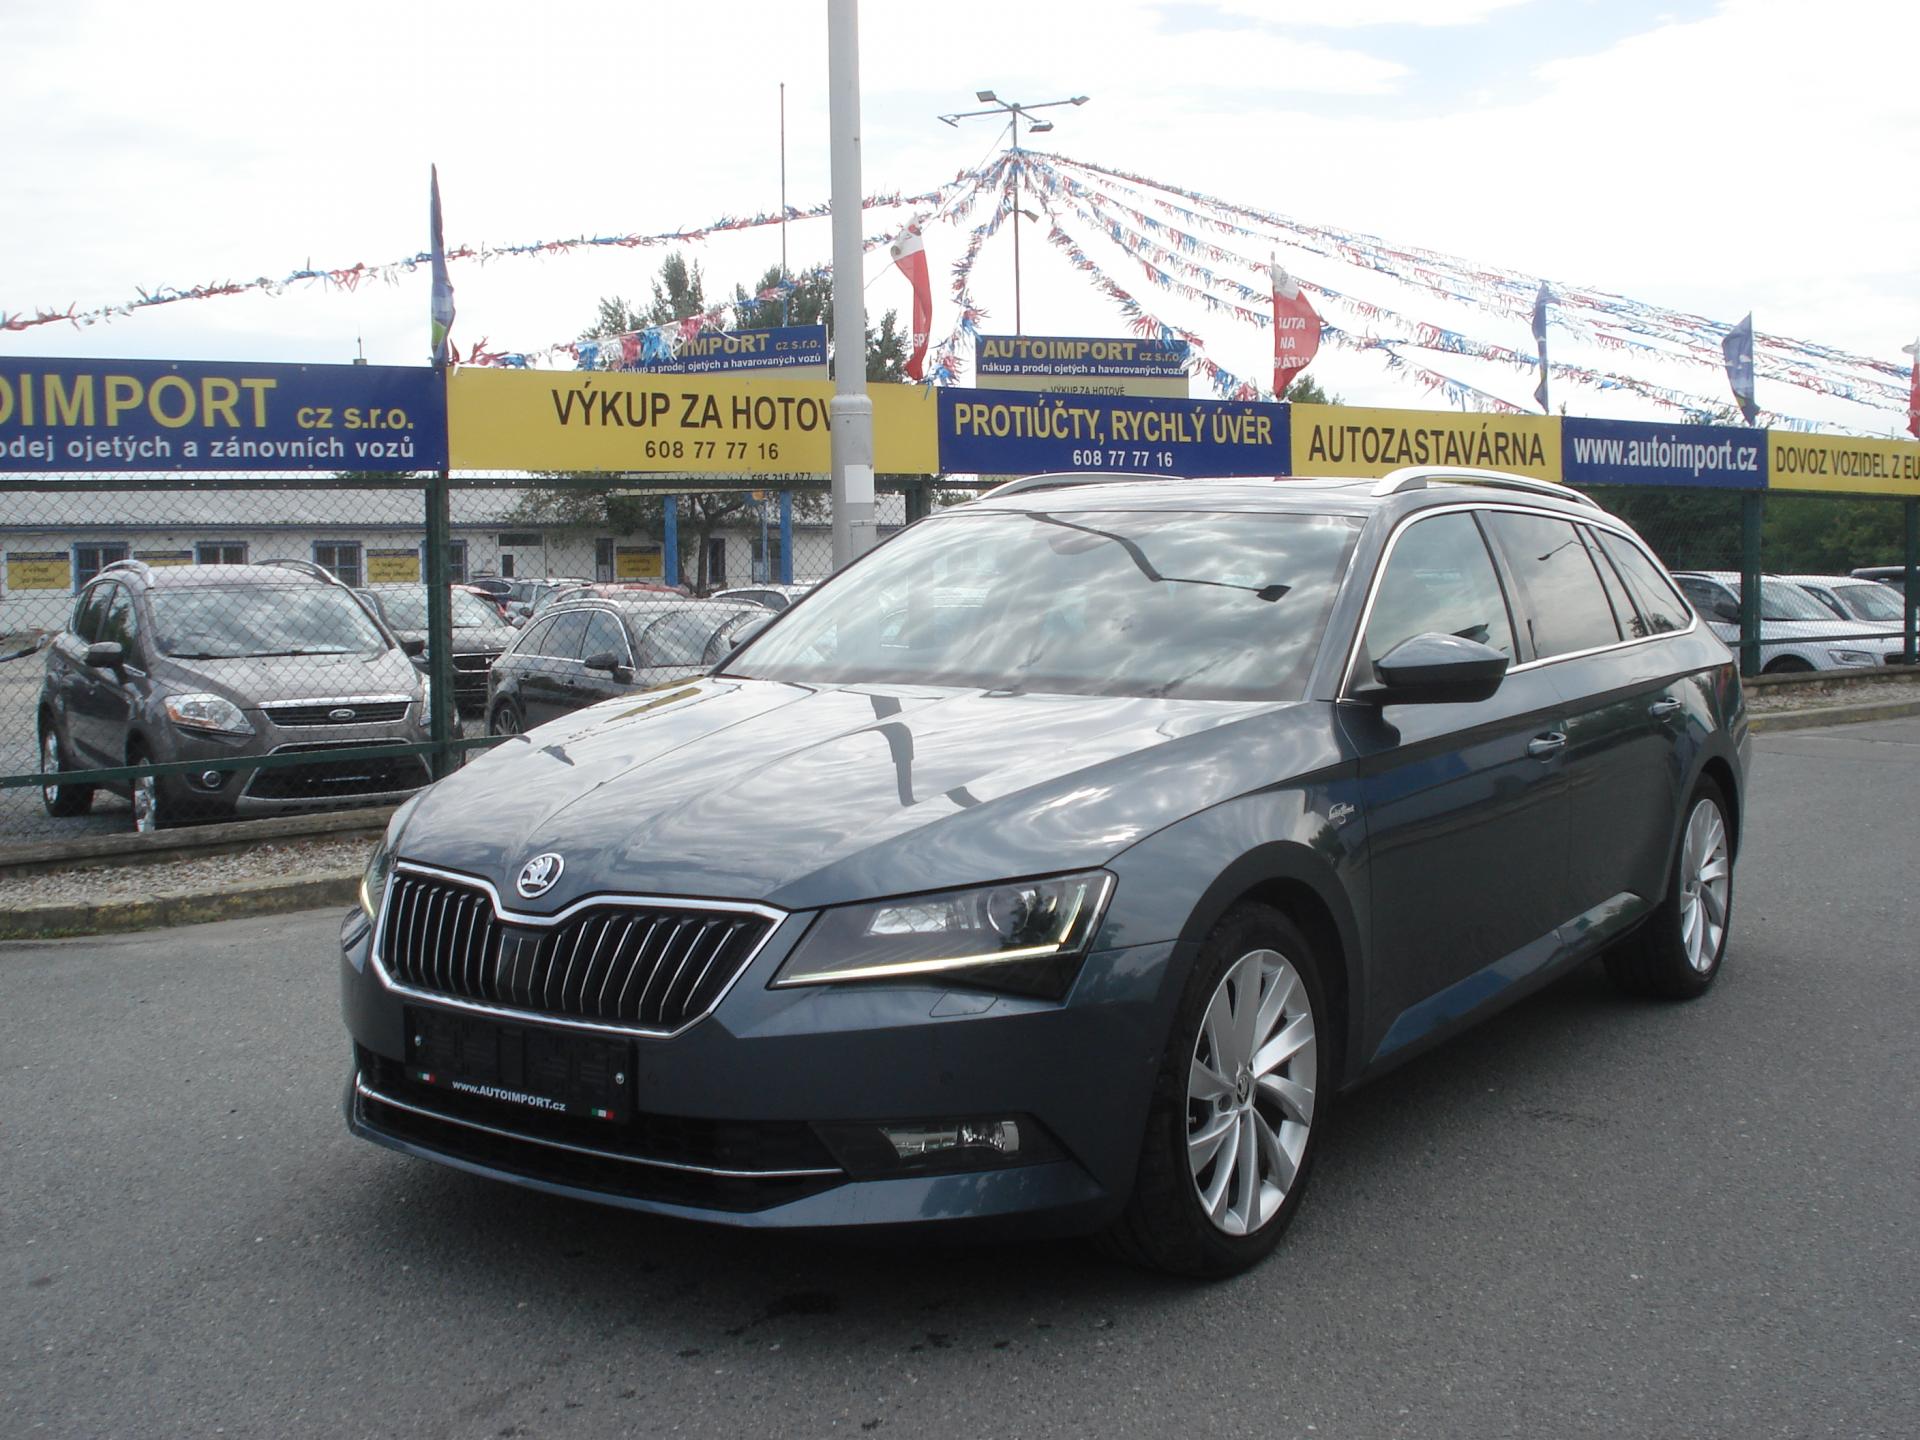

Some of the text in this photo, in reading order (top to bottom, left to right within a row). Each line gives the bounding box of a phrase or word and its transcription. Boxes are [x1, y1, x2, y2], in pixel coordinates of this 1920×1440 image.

[983, 339, 1137, 361] AUTOIMPORT
[1280, 336, 1296, 349] NA
[657, 362, 686, 374] prodej
[688, 359, 721, 372] ojetých
[731, 355, 796, 368] havarovaných
[798, 353, 821, 363] vozů
[982, 363, 1012, 374] nákup
[1022, 363, 1052, 374] prodej
[1055, 363, 1088, 375] ojetých
[1098, 364, 1161, 376] havarovaných
[0, 373, 415, 430] IMPORT cz s.r.o.
[551, 380, 671, 427] VÝKUP
[680, 393, 723, 429] ZA
[954, 400, 1273, 446] PROTIÚČTY, RYCHLÝ ÚVĚR
[67, 435, 171, 462] ojetých
[183, 441, 200, 458] a
[210, 436, 344, 458] zánovních
[355, 435, 415, 458] vozů
[645, 440, 779, 460] 608 77 77 16
[1308, 422, 1546, 466] AUTOZASTAVÁRNA
[1573, 434, 1758, 477] www.autoimport.cz
[1073, 449, 1173, 468] 608 77 77 16
[1776, 446, 1827, 475] DOVOZ
[1831, 449, 1889, 478] VOZIDEL
[1892, 454, 1900, 479] Z
